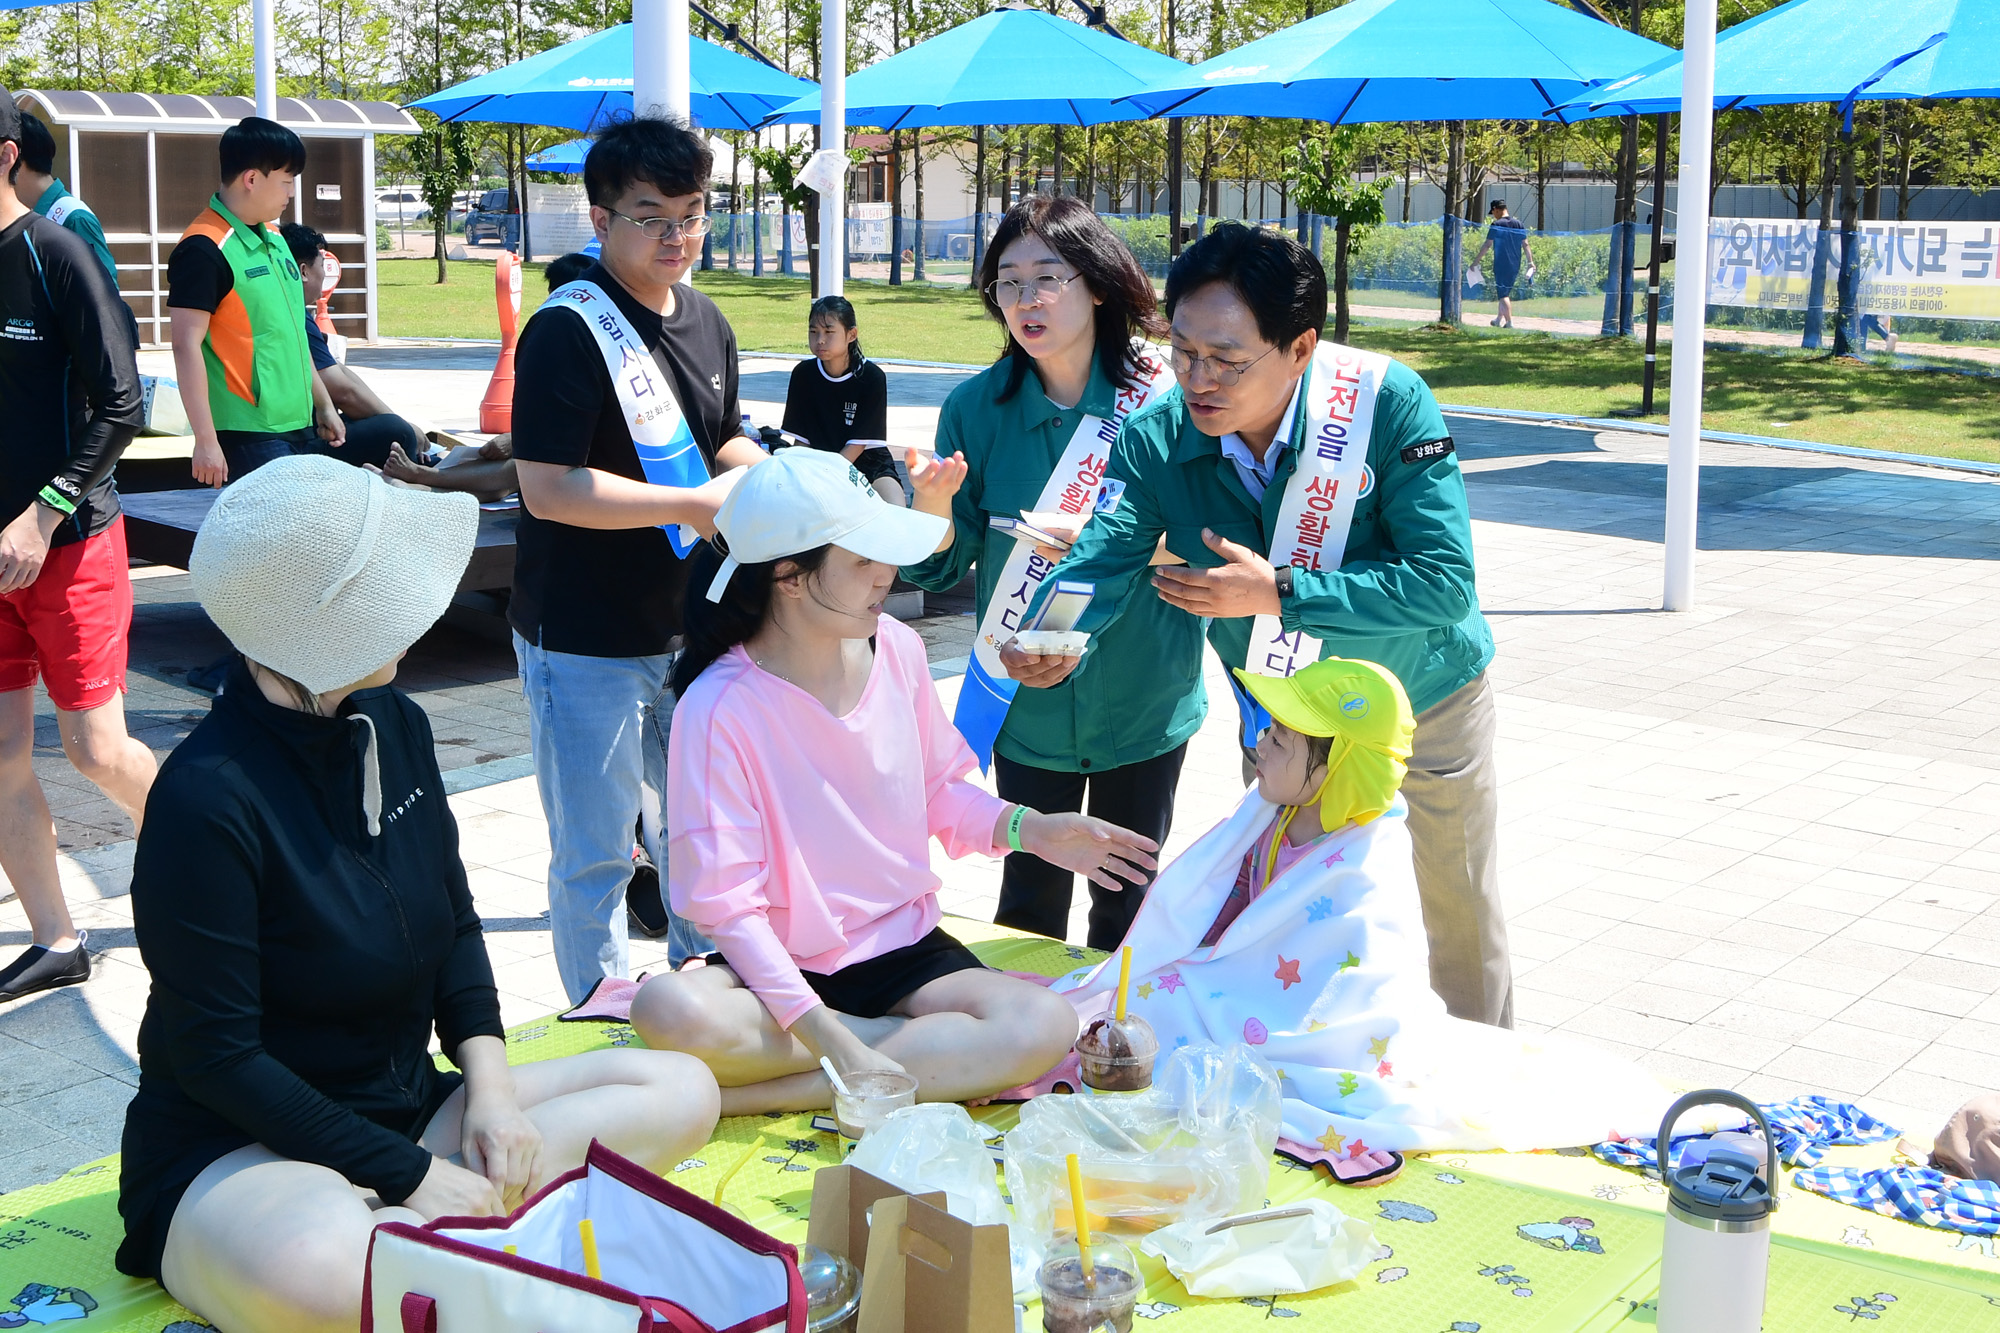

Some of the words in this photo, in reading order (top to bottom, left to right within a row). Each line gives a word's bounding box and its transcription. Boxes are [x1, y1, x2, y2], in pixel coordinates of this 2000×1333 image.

[7, 318, 34, 328] ARGO
[598, 311, 655, 397] 합시다
[644, 400, 672, 422] 강화군
[1316, 353, 1366, 462] 안전을
[1413, 441, 1444, 458] 강화군
[50, 475, 81, 497] ARGO
